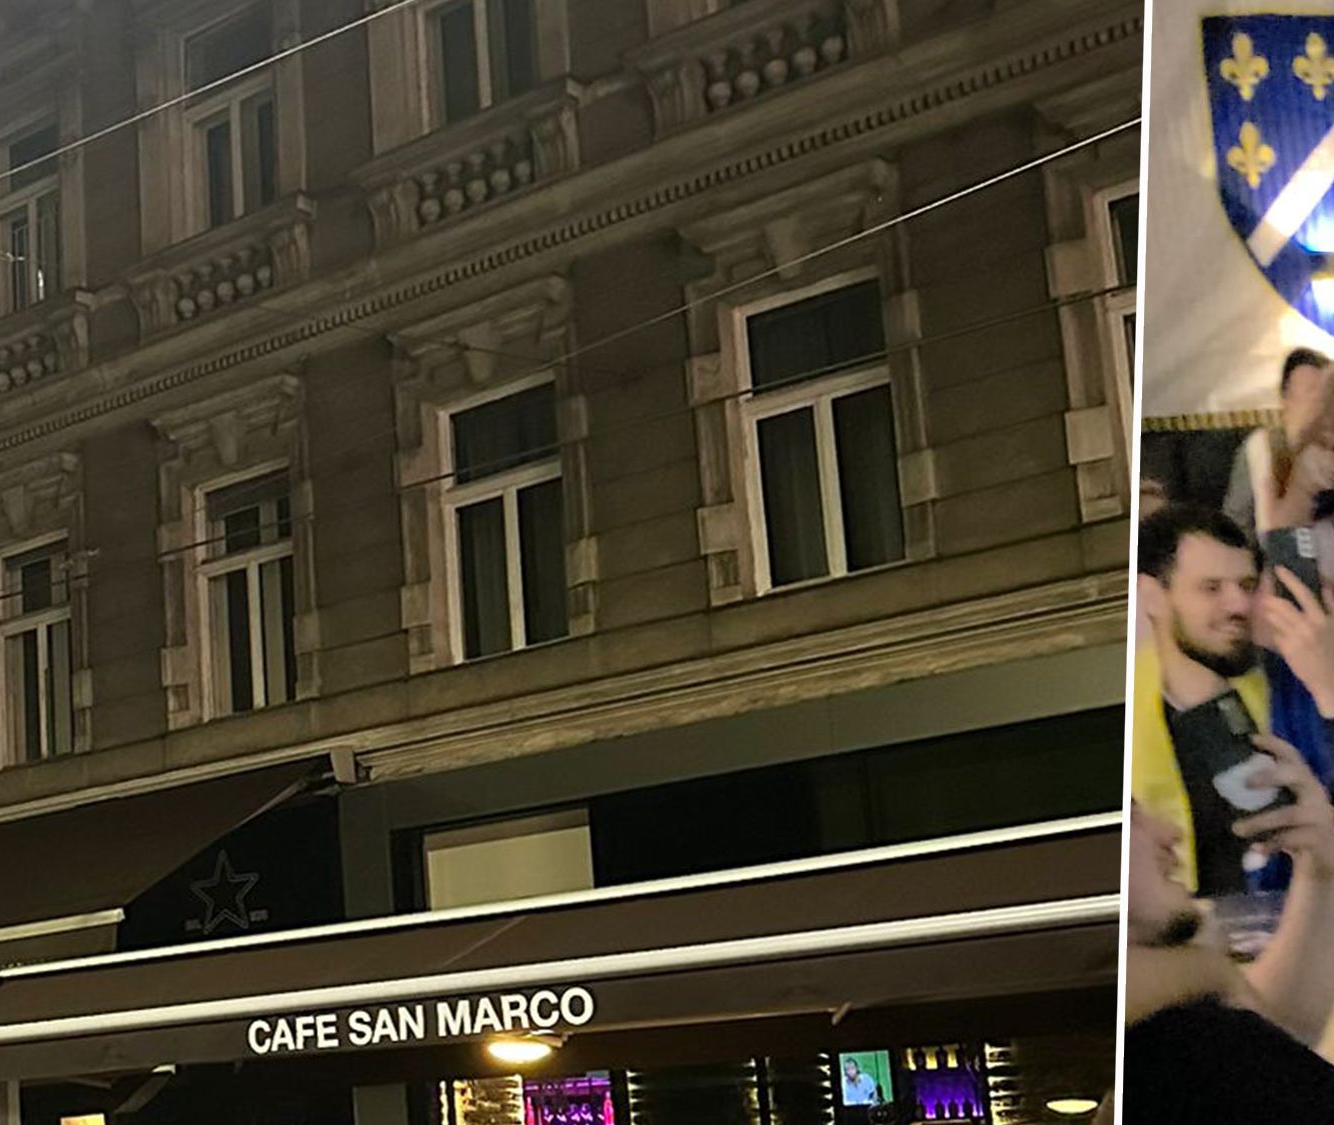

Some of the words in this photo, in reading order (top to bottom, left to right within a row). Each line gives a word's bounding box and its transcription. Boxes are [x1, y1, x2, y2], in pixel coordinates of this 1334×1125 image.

[247, 1019, 339, 1055] CAFE
[348, 1004, 425, 1046] SAN
[436, 986, 595, 1038] MARCO
